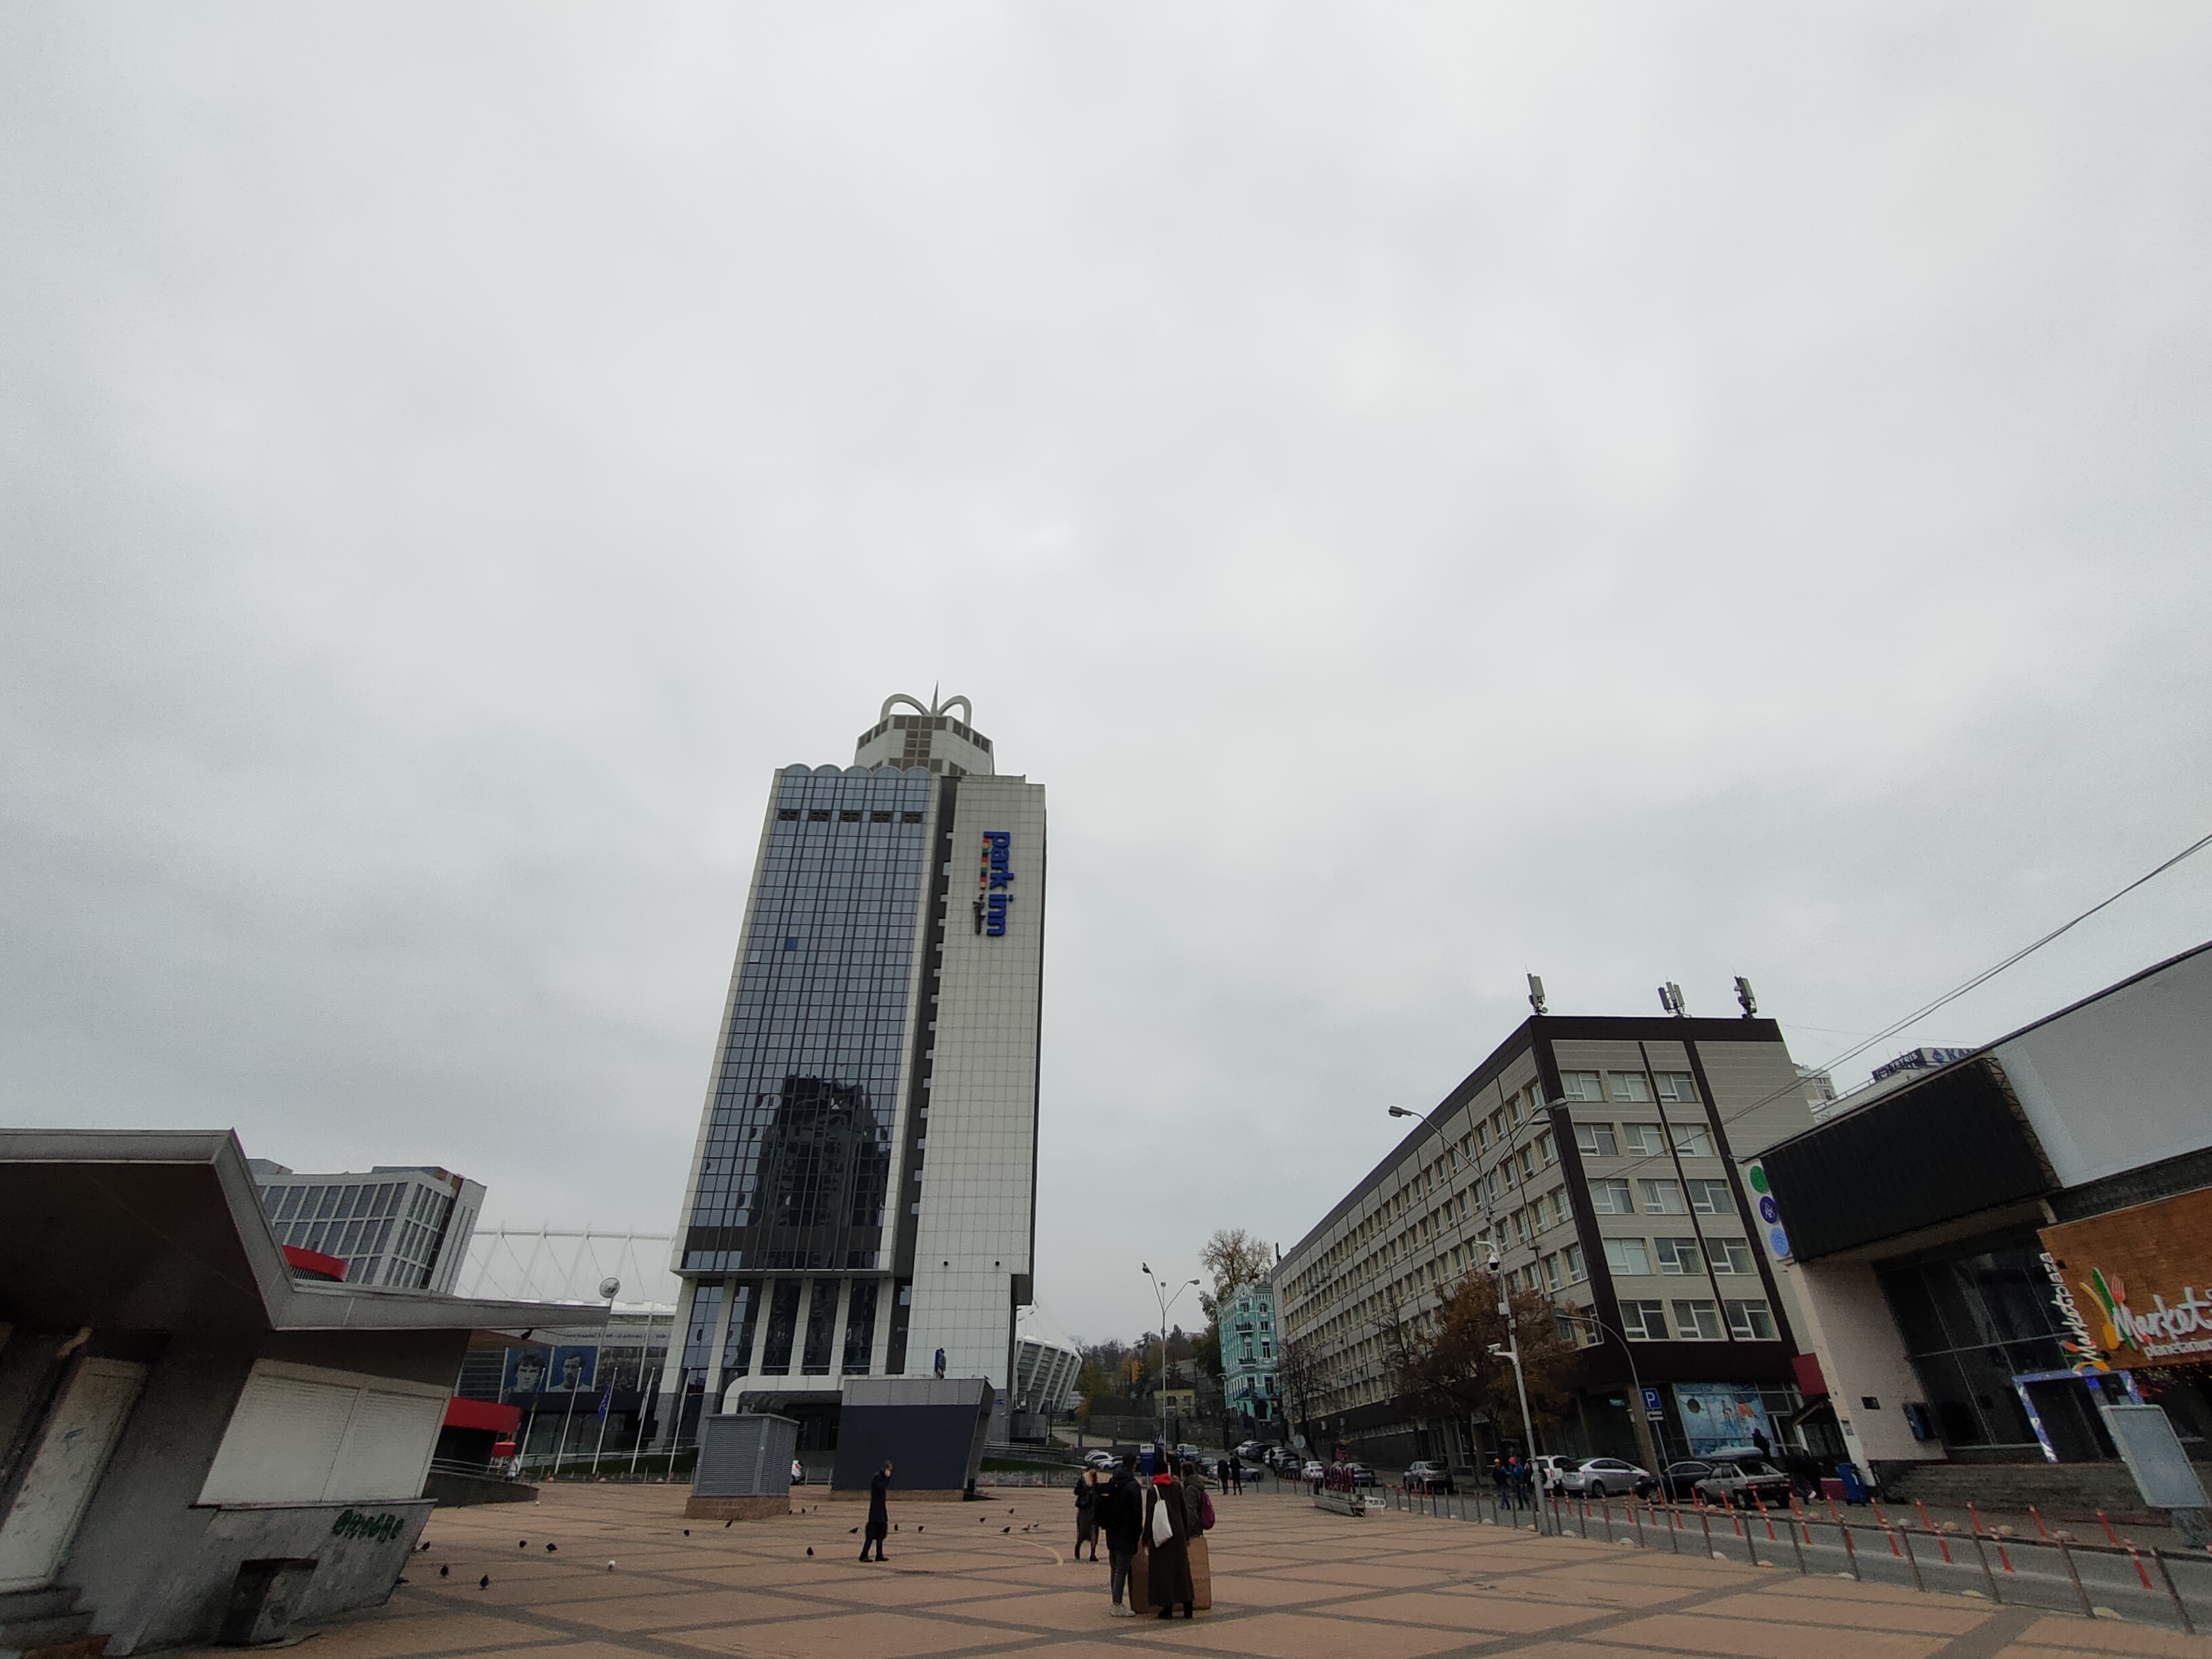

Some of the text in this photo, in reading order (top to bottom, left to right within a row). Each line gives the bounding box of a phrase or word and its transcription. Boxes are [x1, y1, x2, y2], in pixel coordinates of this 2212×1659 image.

[983, 831, 1015, 936] park inn
[1645, 1391, 1656, 1408] P
